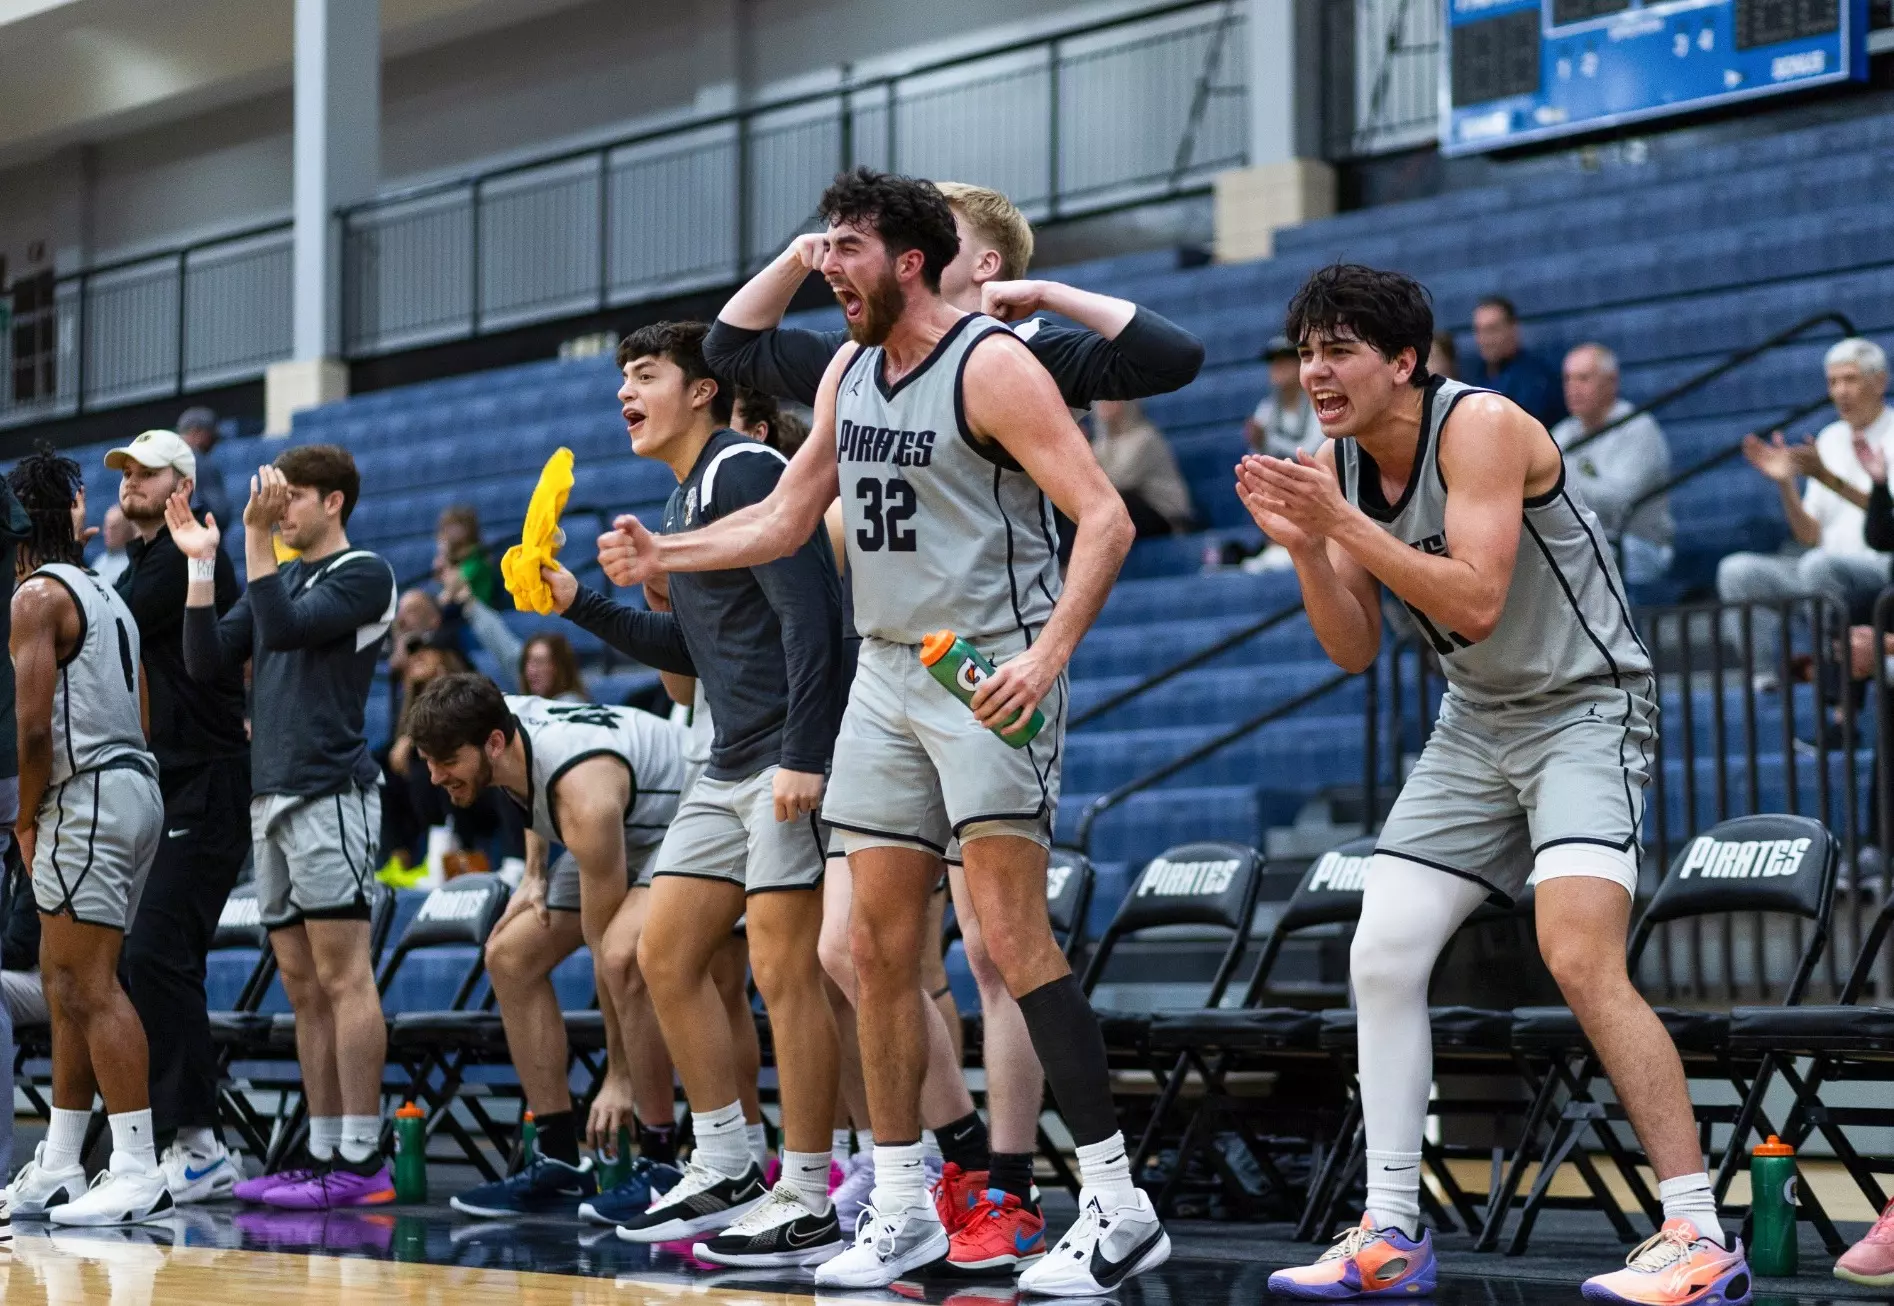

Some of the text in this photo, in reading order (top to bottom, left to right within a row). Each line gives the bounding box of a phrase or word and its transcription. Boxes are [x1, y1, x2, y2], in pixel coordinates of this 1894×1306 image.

[838, 419, 937, 468] PIRATES
[856, 477, 917, 552] 32
[1136, 858, 1241, 898] PIRATES
[1307, 851, 1374, 893] PIRA
[1679, 836, 1812, 880] PIRATES
